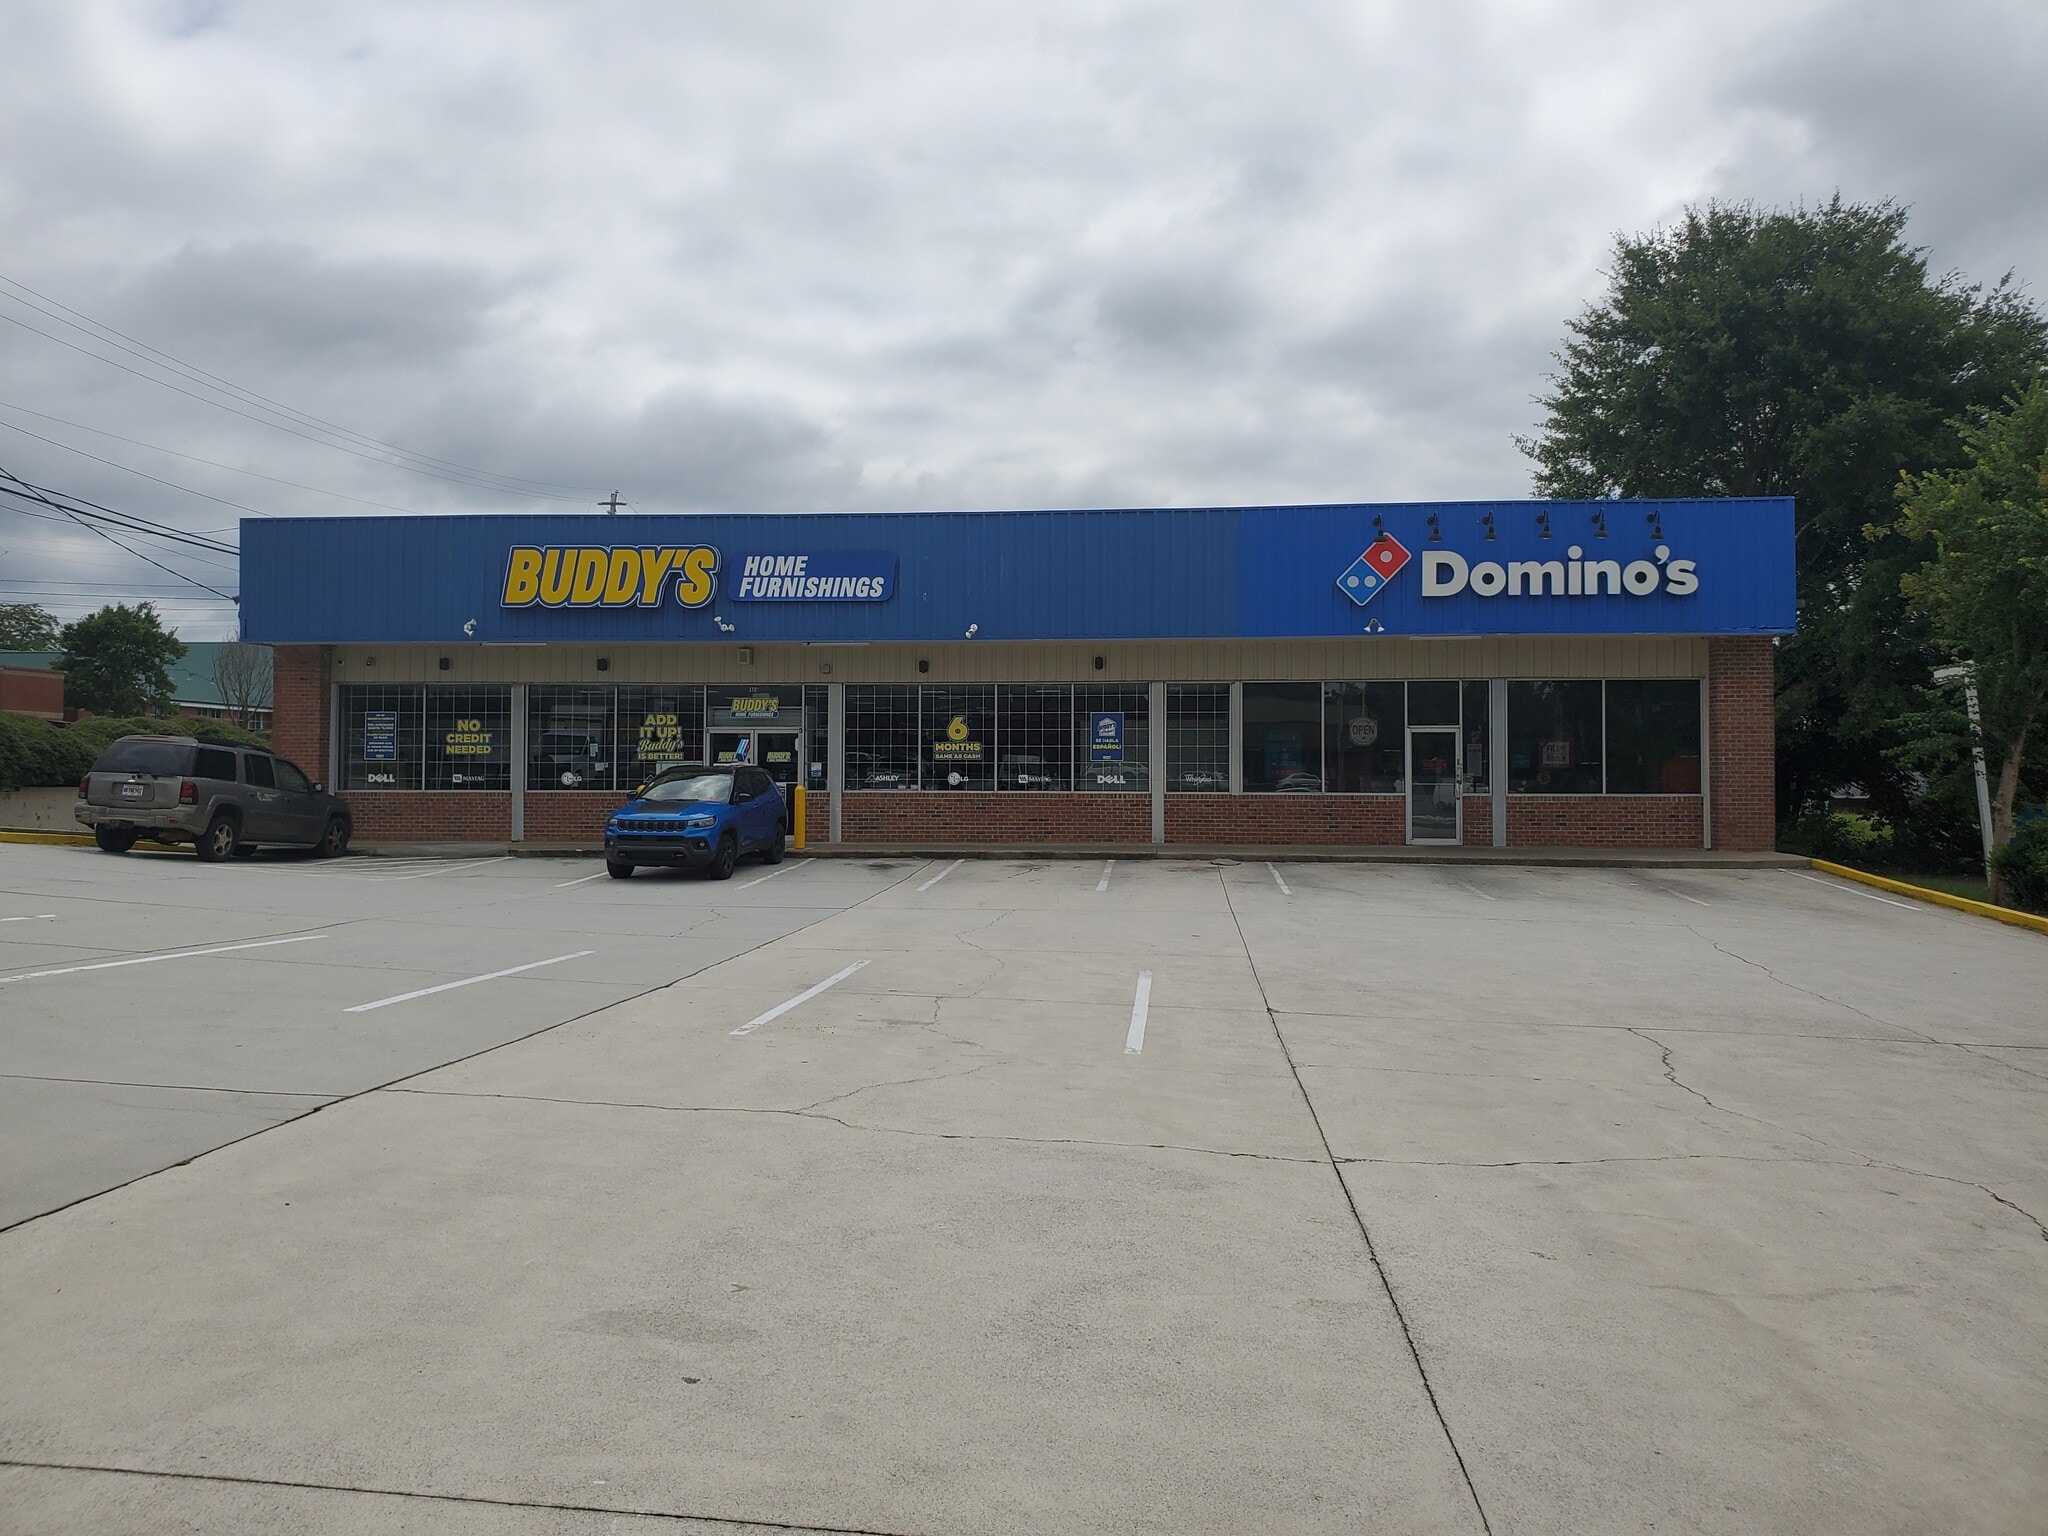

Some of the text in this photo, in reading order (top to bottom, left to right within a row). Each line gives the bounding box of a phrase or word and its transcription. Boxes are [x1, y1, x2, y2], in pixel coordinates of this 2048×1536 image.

[744, 555, 808, 577] HOME
[1422, 544, 1699, 597] Domino's
[503, 547, 720, 607] BUDDY'S
[739, 576, 885, 599] FURNISHINGS
[732, 698, 779, 712] BUDDY'S
[457, 719, 481, 732] NO
[645, 714, 677, 725] ADD
[639, 726, 683, 738] IT UP!
[947, 715, 969, 741] 6
[1352, 724, 1375, 735] OPEN
[446, 733, 492, 744] CREDIT
[638, 737, 685, 752] Buddy's
[446, 744, 492, 755] NEEDED
[935, 742, 981, 751] MONTHS
[367, 773, 395, 783] DELL
[1097, 775, 1126, 785] DELL
